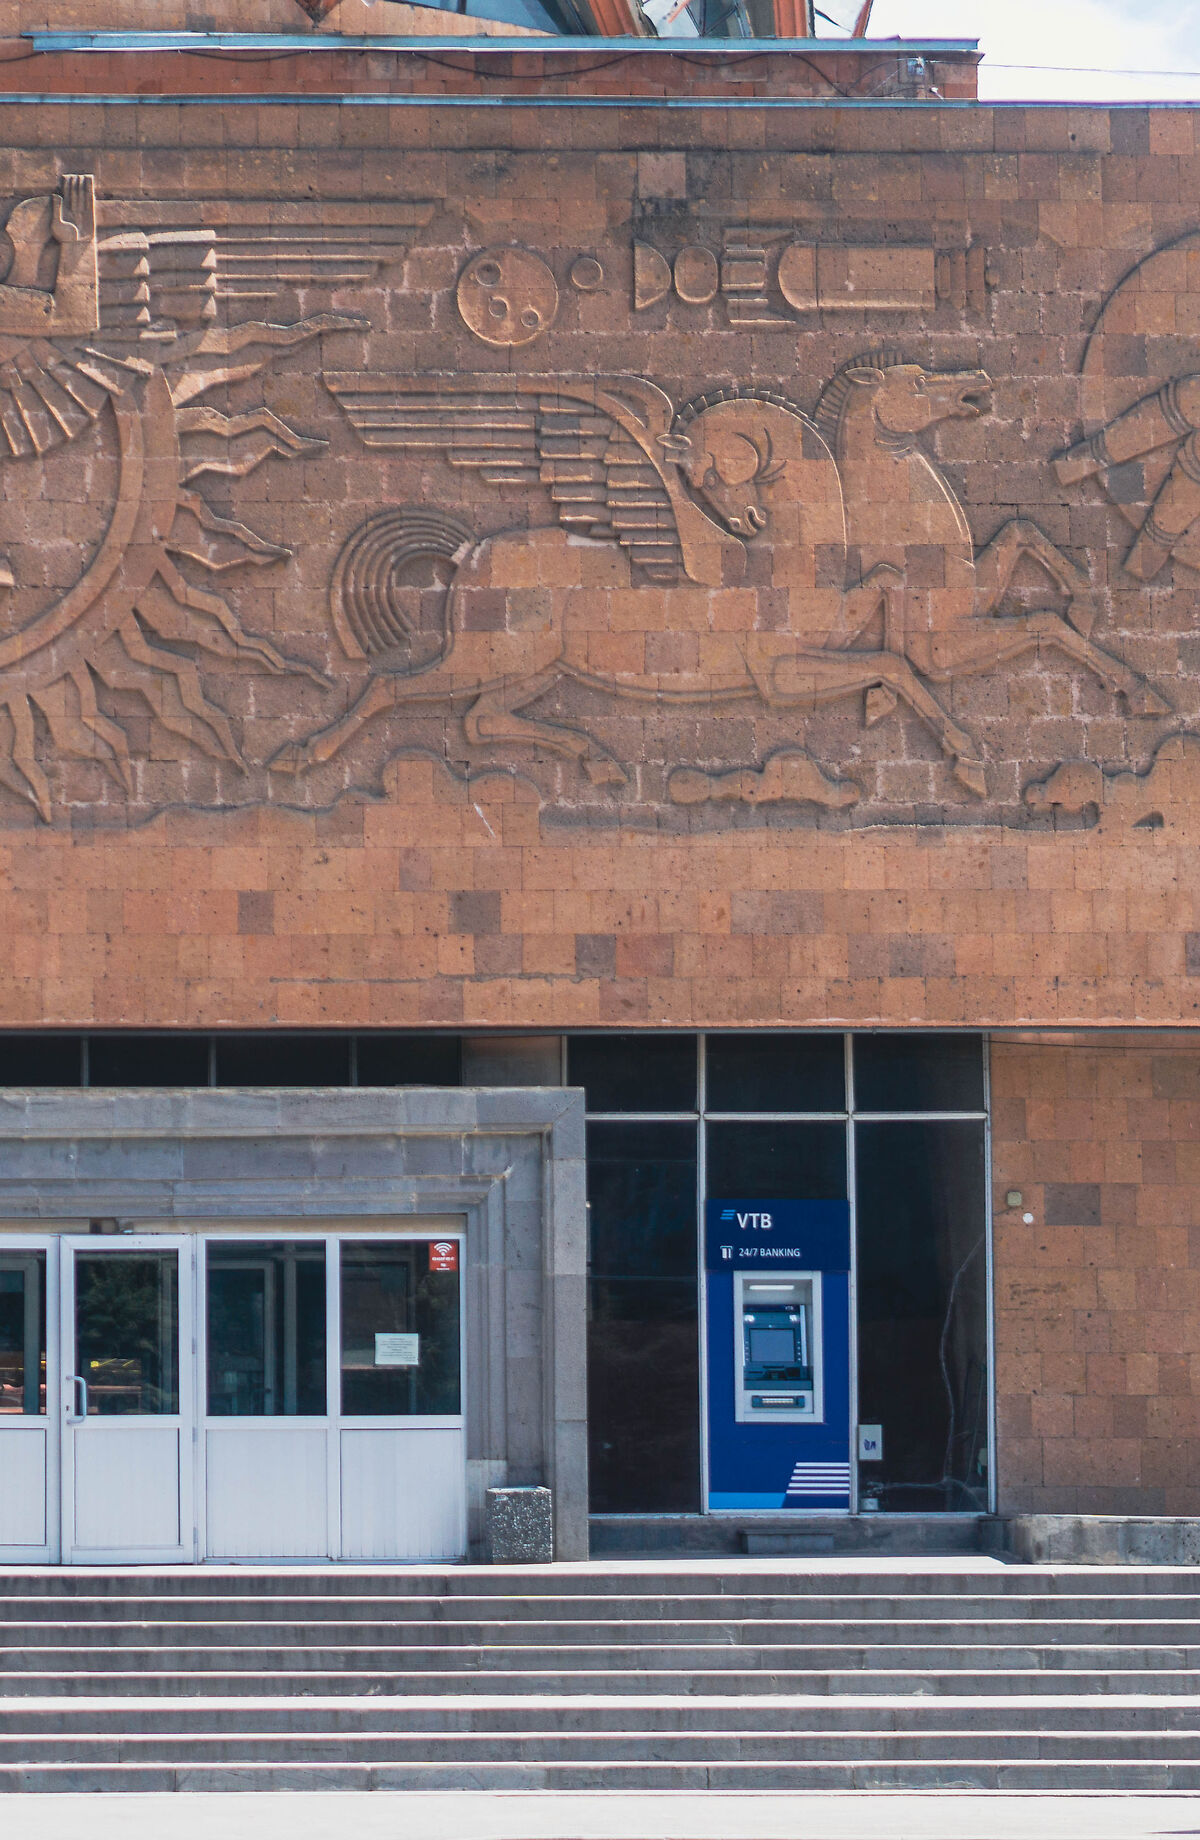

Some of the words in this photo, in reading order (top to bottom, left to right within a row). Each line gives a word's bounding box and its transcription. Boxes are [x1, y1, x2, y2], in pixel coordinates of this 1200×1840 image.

[736, 1212, 772, 1229] VTB
[738, 1247, 758, 1257] 24/7
[759, 1247, 801, 1257] BANKING
